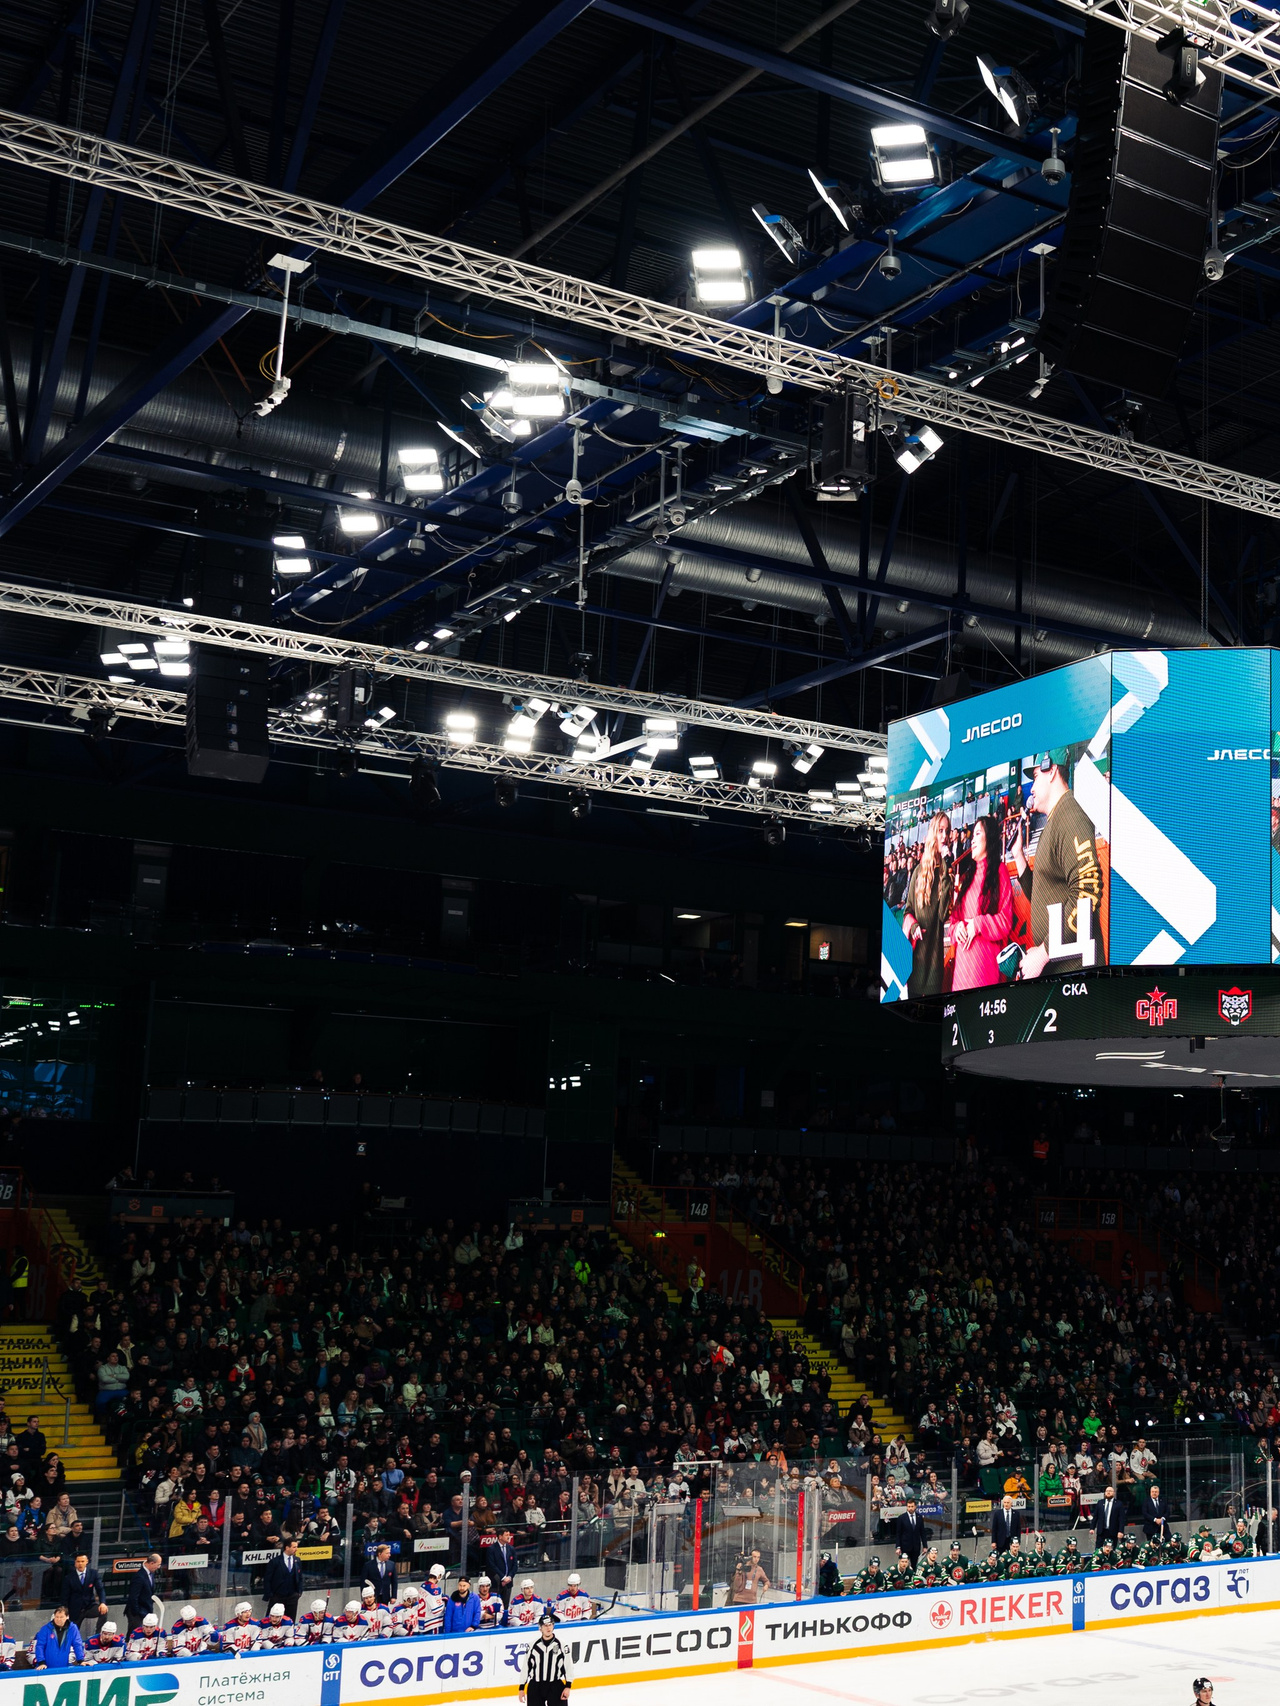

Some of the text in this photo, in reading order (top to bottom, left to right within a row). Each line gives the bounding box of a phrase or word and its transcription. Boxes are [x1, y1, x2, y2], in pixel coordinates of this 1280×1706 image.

[961, 712, 1023, 744] JAECOO
[1062, 983, 1088, 997] СКА
[979, 999, 1007, 1018] 14:56
[1043, 1009, 1057, 1033] 2
[952, 1023, 958, 1046] 2
[988, 1029, 995, 1044] 3
[358, 1141, 365, 1152] 6
[829, 1512, 856, 1521] FONBET
[481, 1535, 514, 1545] FONT
[117, 1561, 142, 1570] Winline
[244, 1552, 280, 1562] KHL.RU
[959, 1591, 1064, 1626] RIEKER
[765, 1610, 913, 1641] ТИНЬКОФФ
[199, 1669, 291, 1689] Платёжная
[22, 1672, 180, 1706] МИР
[198, 1688, 265, 1706] система
